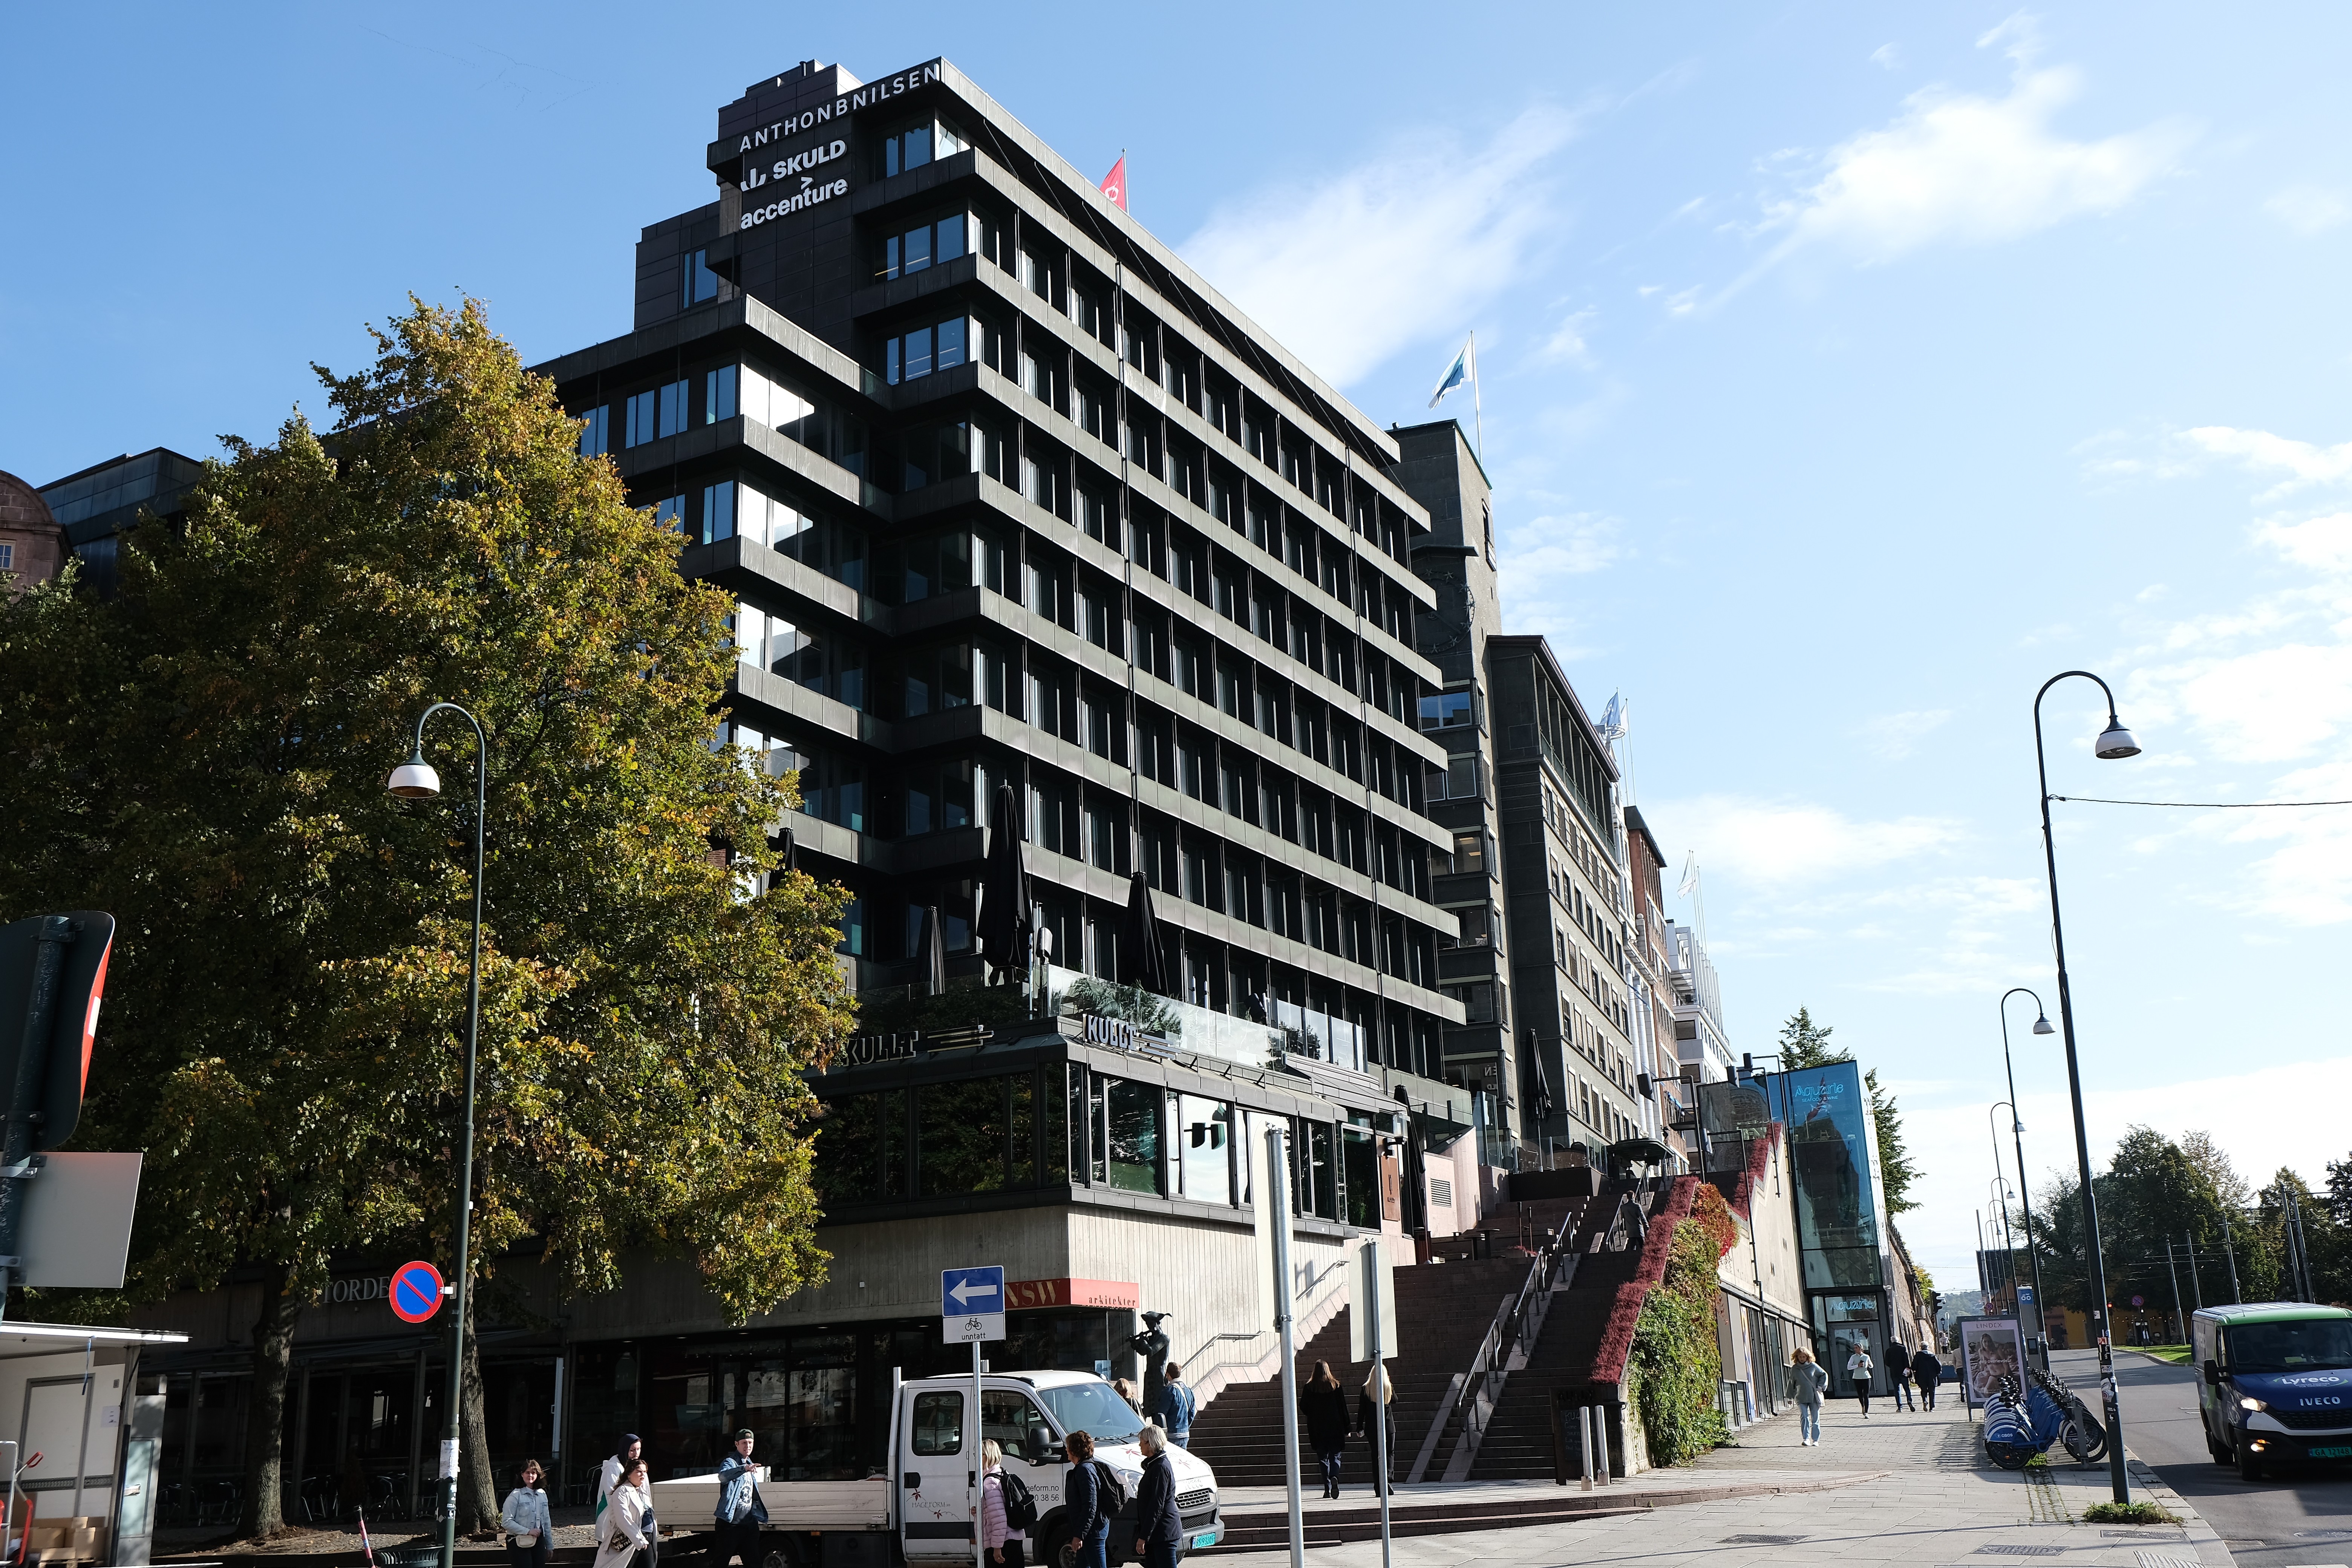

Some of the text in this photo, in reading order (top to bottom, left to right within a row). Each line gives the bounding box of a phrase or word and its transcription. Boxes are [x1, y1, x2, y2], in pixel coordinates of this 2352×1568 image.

[773, 140, 847, 179] SKULD
[741, 178, 848, 230] accenture
[1795, 1082, 1844, 1098] Aquarie
[1004, 1280, 1136, 1307] NSW arkitekter
[2282, 1377, 2340, 1386] Lyreco
[2300, 1396, 2340, 1406] IVECO
